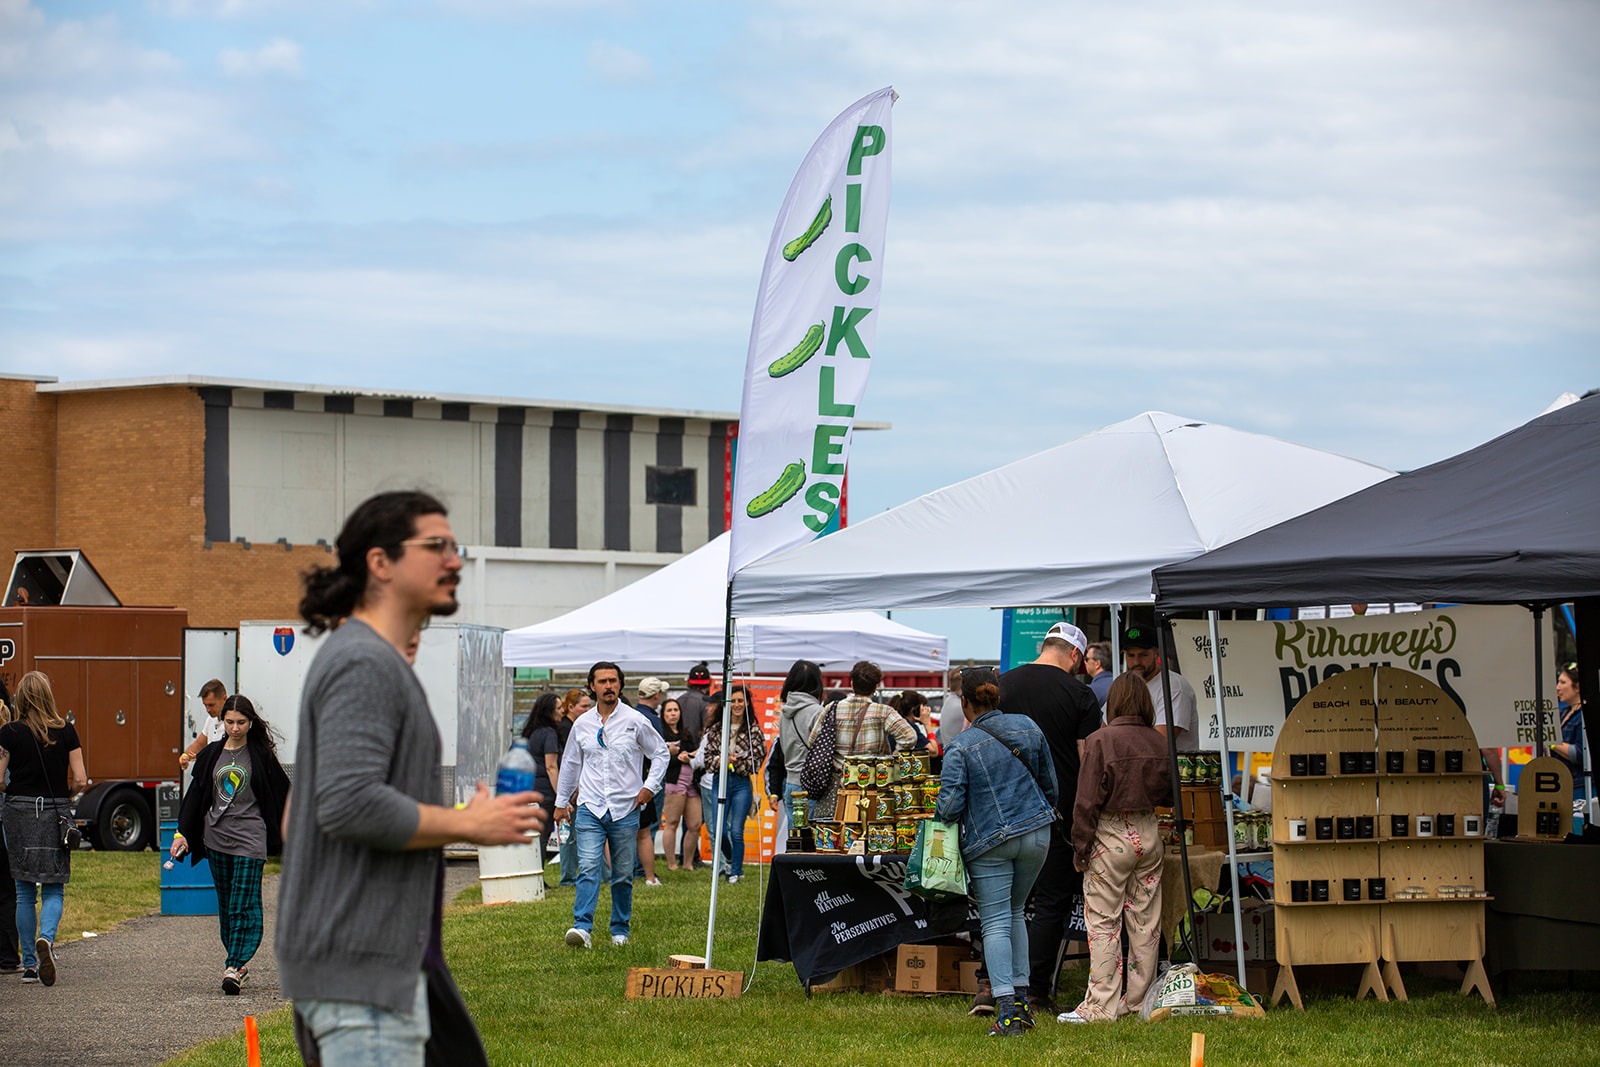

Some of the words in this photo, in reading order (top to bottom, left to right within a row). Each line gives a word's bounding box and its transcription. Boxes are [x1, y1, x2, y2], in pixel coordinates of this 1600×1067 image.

[803, 125, 887, 534] PICKLES
[1273, 615, 1457, 671] Kilhaney's
[1312, 700, 1350, 709] BEACH
[1360, 698, 1388, 706] BUM
[1394, 697, 1439, 706] BEAUTY
[1208, 725, 1274, 739] PESERVATIVES
[1535, 772, 1561, 793] B
[816, 893, 855, 914] NATURAL
[830, 921, 847, 935] No
[834, 913, 898, 944] PERSERVATIVES
[639, 974, 726, 998] PICKLES
